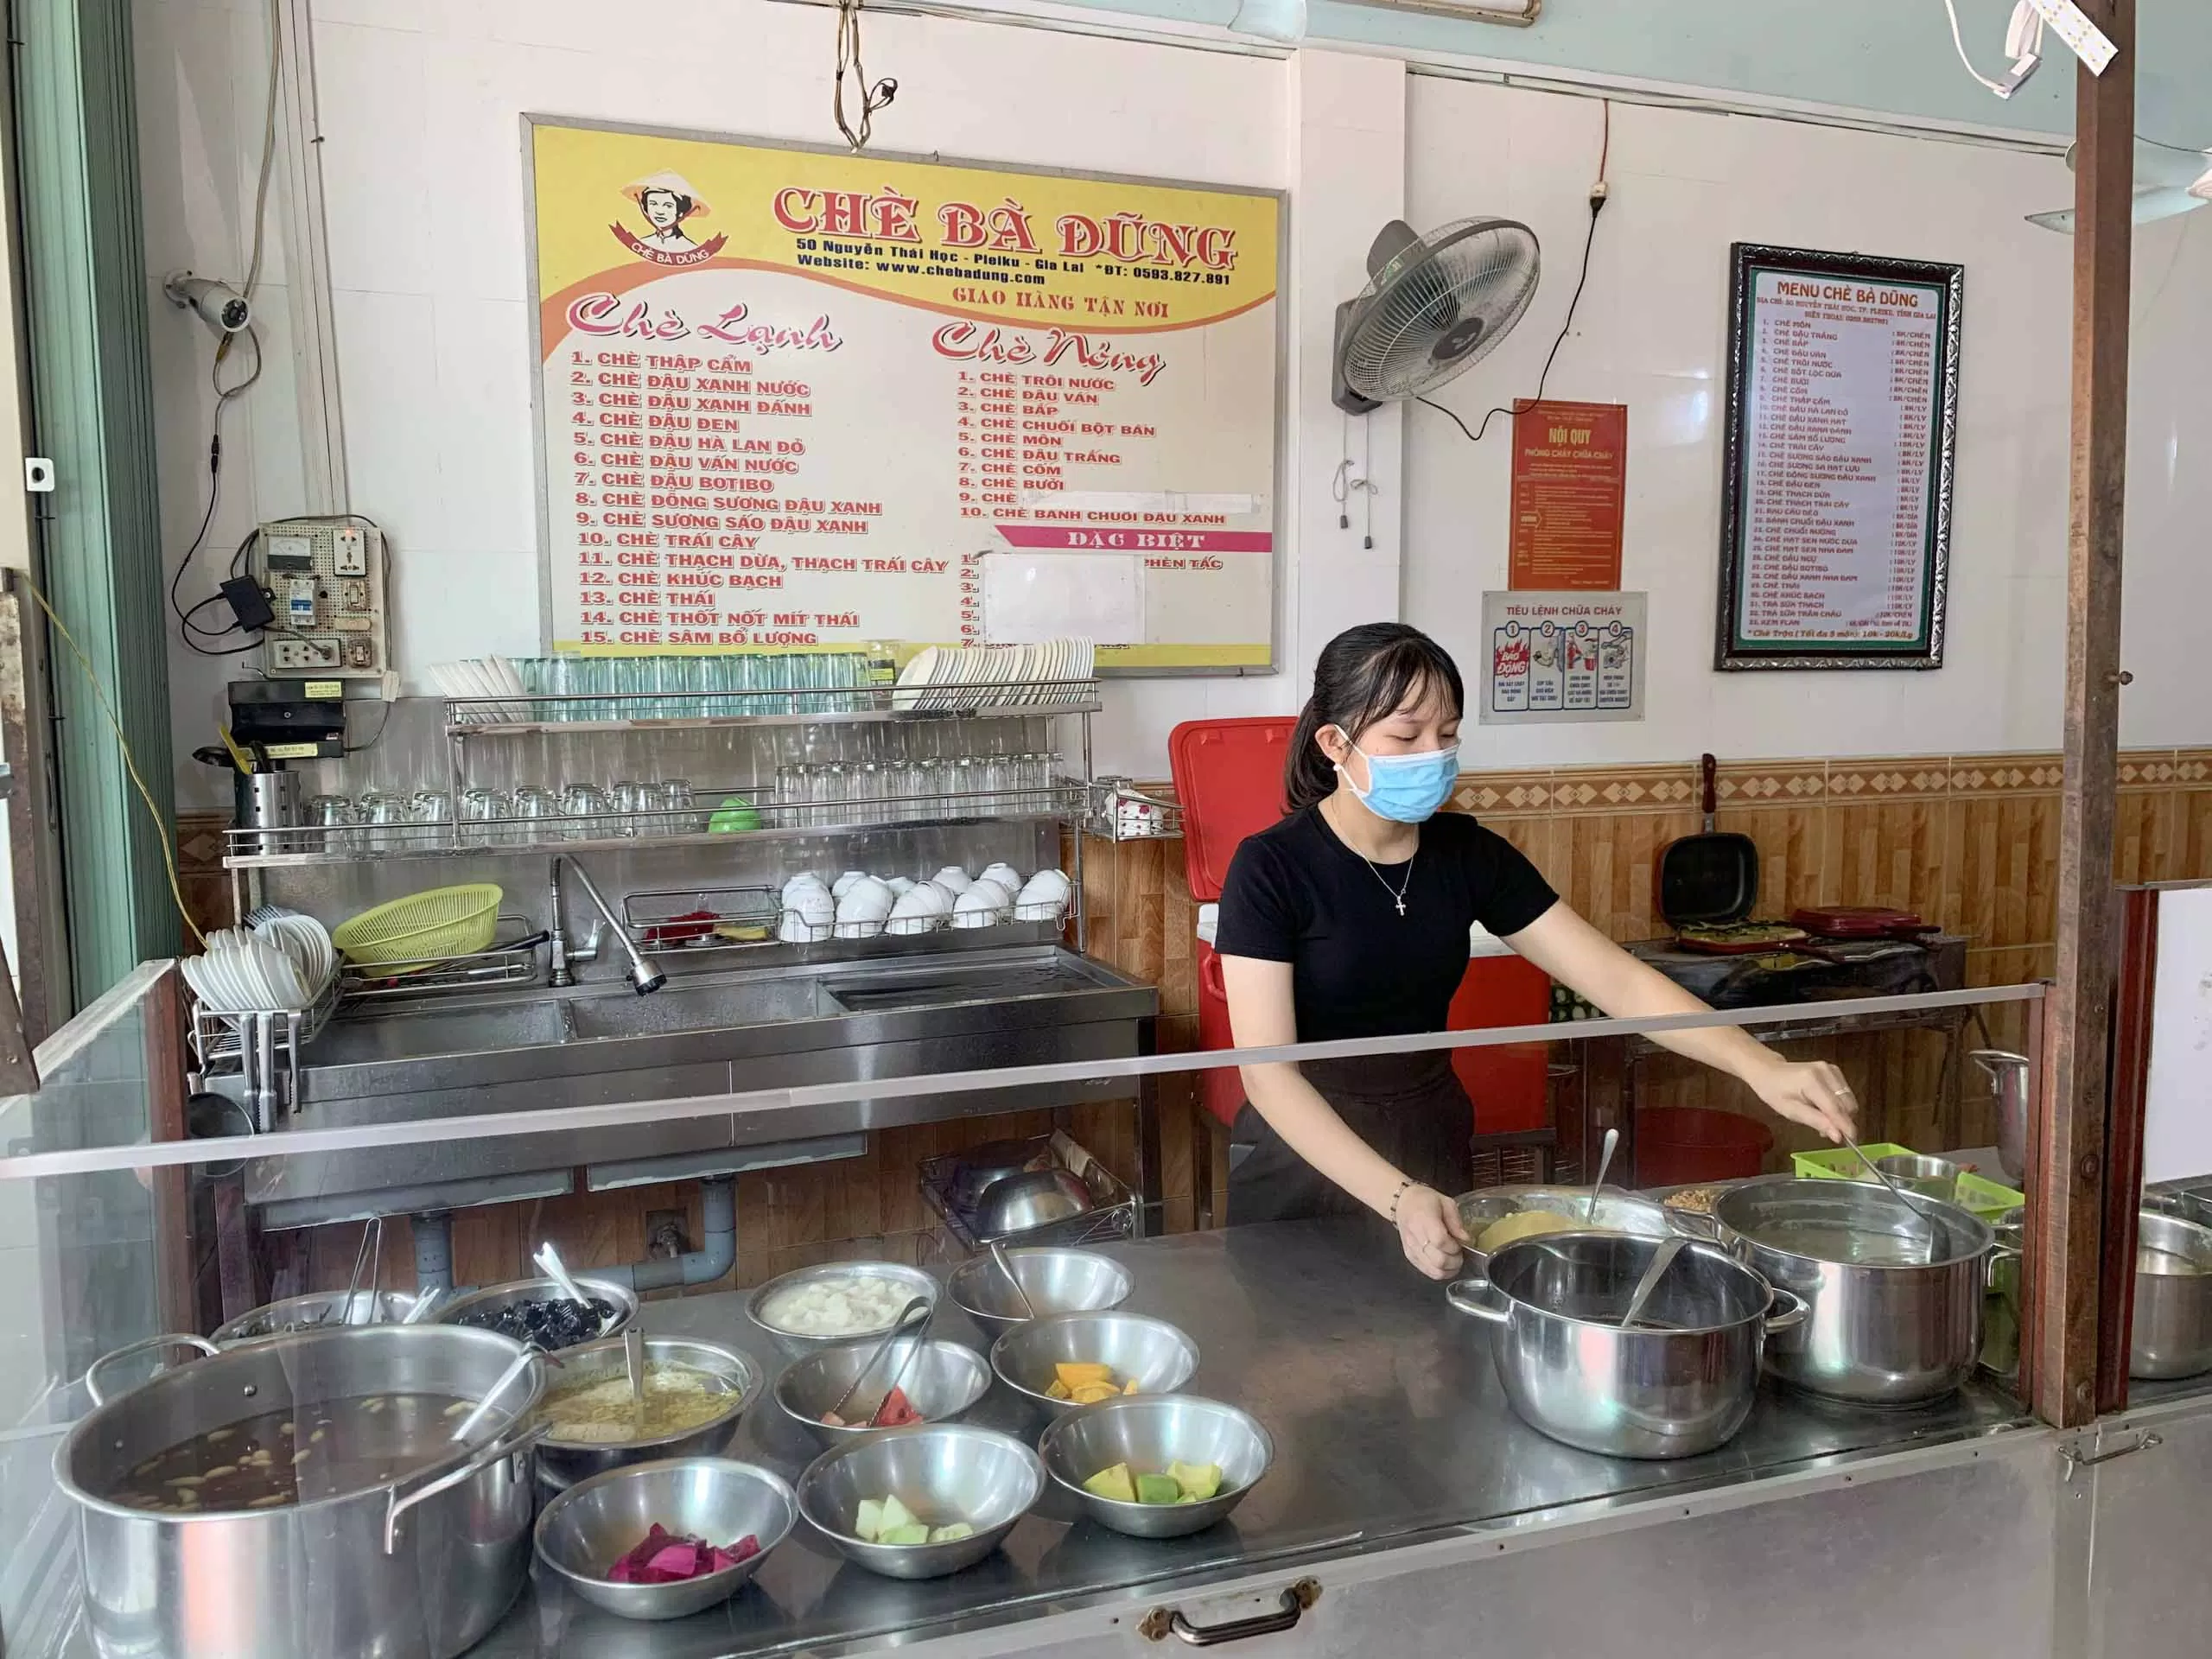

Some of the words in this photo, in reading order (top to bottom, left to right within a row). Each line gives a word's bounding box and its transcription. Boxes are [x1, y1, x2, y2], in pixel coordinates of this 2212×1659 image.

[773, 186, 922, 244] CHÈ
[938, 197, 1043, 254] BÀ
[632, 243, 655, 259] CHÈ
[657, 252, 672, 264] BÀ
[797, 238, 817, 251] 50
[823, 240, 883, 257] Nguyễn
[890, 245, 924, 260] Thái
[930, 249, 958, 264] Học
[975, 253, 1020, 267] Pleiku
[1035, 259, 1058, 270] Gia
[1063, 261, 1084, 273] Lai
[798, 254, 869, 270] Website:
[876, 262, 1045, 284] www.chebadung.com
[952, 287, 1006, 306] GIAO
[1016, 290, 1075, 311] HÀNG
[1084, 296, 1125, 318] TẬN
[1135, 301, 1169, 318] NƠI
[1777, 281, 1820, 298] MENU
[1823, 284, 1852, 302] CHÈ
[1856, 287, 1876, 304] BÀ
[1880, 289, 1919, 308] DŨNG
[567, 292, 689, 340] Chè
[698, 303, 842, 354] Lạnh
[932, 320, 1036, 365] Chè
[569, 351, 591, 364] 1.
[597, 352, 638, 366] CHÈ
[647, 354, 702, 372] THẬP
[707, 353, 751, 373] CẨM
[570, 371, 592, 384] 2.
[597, 372, 639, 386] CHÈ
[646, 373, 688, 391] ĐẬU
[697, 378, 751, 392] XANH
[756, 378, 808, 396] NƯỚC
[957, 371, 974, 381] 1.
[980, 372, 1014, 384] CHÈ
[1068, 375, 1115, 390] NƯỚC
[571, 391, 592, 404] 3.
[598, 391, 639, 406] CHÈ
[647, 393, 689, 410] ĐẬU
[697, 398, 749, 412] XANH
[957, 386, 974, 397] 2.
[980, 387, 1014, 398] CHÈ
[1021, 389, 1058, 403] ĐẬU
[958, 401, 974, 411] 3.
[980, 402, 1014, 414] CHÈ
[572, 411, 593, 424] 4.
[599, 411, 640, 427] CHÈ
[648, 413, 690, 430] ĐẬU
[696, 417, 738, 431] ĐEN
[958, 416, 975, 427] 4.
[980, 416, 1014, 429] CHÈ
[1080, 423, 1116, 435] BỘT
[573, 431, 594, 444] 5.
[600, 431, 641, 447] CHÈ
[648, 433, 690, 450] ĐẬU
[697, 435, 724, 450] HÀ
[732, 439, 770, 452] LAN
[776, 436, 804, 454] ĐỎ
[958, 432, 975, 442] 5.
[980, 432, 1014, 444] CHÈ
[1022, 434, 1062, 446] MÔN
[1570, 429, 1592, 446] QUY
[573, 452, 594, 464] 6.
[601, 451, 641, 467] CHÈ
[649, 453, 691, 470] ĐẬU
[745, 455, 793, 473] NƯỚC
[958, 447, 975, 457] 6.
[980, 447, 1014, 459] CHÈ
[1022, 448, 1058, 462] ĐẬU
[958, 462, 975, 472] 7.
[981, 462, 1014, 474] CHÈ
[574, 472, 594, 484] 7.
[601, 471, 642, 486] CHÈ
[650, 473, 692, 490] ĐẬU
[698, 477, 773, 491] BOTIBO
[958, 477, 975, 487] 8.
[981, 477, 1014, 488] CHÈ
[575, 492, 595, 504] 8.
[602, 491, 643, 505] CHÈ
[651, 493, 707, 508] ĐÔNG
[714, 495, 779, 511] SƯƠNG
[784, 498, 823, 514] ĐẬU
[832, 501, 880, 514] XANH
[959, 492, 975, 502] 9.
[981, 492, 1014, 504] CHÈ
[575, 512, 596, 524] 9.
[602, 511, 643, 525] CHÈ
[652, 512, 719, 528] SƯƠNG
[725, 512, 766, 530] SÁO
[770, 516, 810, 533] ĐẬU
[817, 520, 867, 533] XANH
[961, 507, 987, 518] 10.
[994, 507, 1027, 518] CHÈ
[1183, 515, 1226, 526] XANH
[578, 531, 611, 544] 10.
[617, 531, 656, 545] CHÈ
[665, 530, 712, 547] TRÁI
[718, 534, 760, 549] CÂY
[1067, 531, 1124, 548] ĐẶC
[1137, 532, 1205, 550] BIỆT
[579, 551, 611, 563] 11.
[618, 550, 656, 565] CHÈ
[665, 554, 733, 569] THẠCH
[792, 557, 856, 572] THẠCH
[862, 555, 906, 572] TRÁI
[912, 558, 948, 573] CÂY
[580, 571, 612, 583] 12.
[617, 570, 658, 584] CHÈ
[666, 569, 721, 586] KHÚC
[728, 575, 781, 589] BẠCH
[581, 591, 613, 603] 13.
[618, 589, 658, 604] CHÈ
[667, 588, 714, 605] THÁI
[581, 610, 613, 622] 14.
[620, 609, 658, 623] CHÈ
[815, 610, 858, 626] THÁI
[582, 630, 613, 642] 15.
[620, 628, 660, 643] CHÈ
[670, 629, 711, 644] SÂM
[718, 626, 747, 644] BỔ
[753, 631, 816, 647] LƯỢNG
[1544, 625, 1550, 633] 2
[1579, 625, 1585, 633] 3
[1611, 624, 1618, 633] 4
